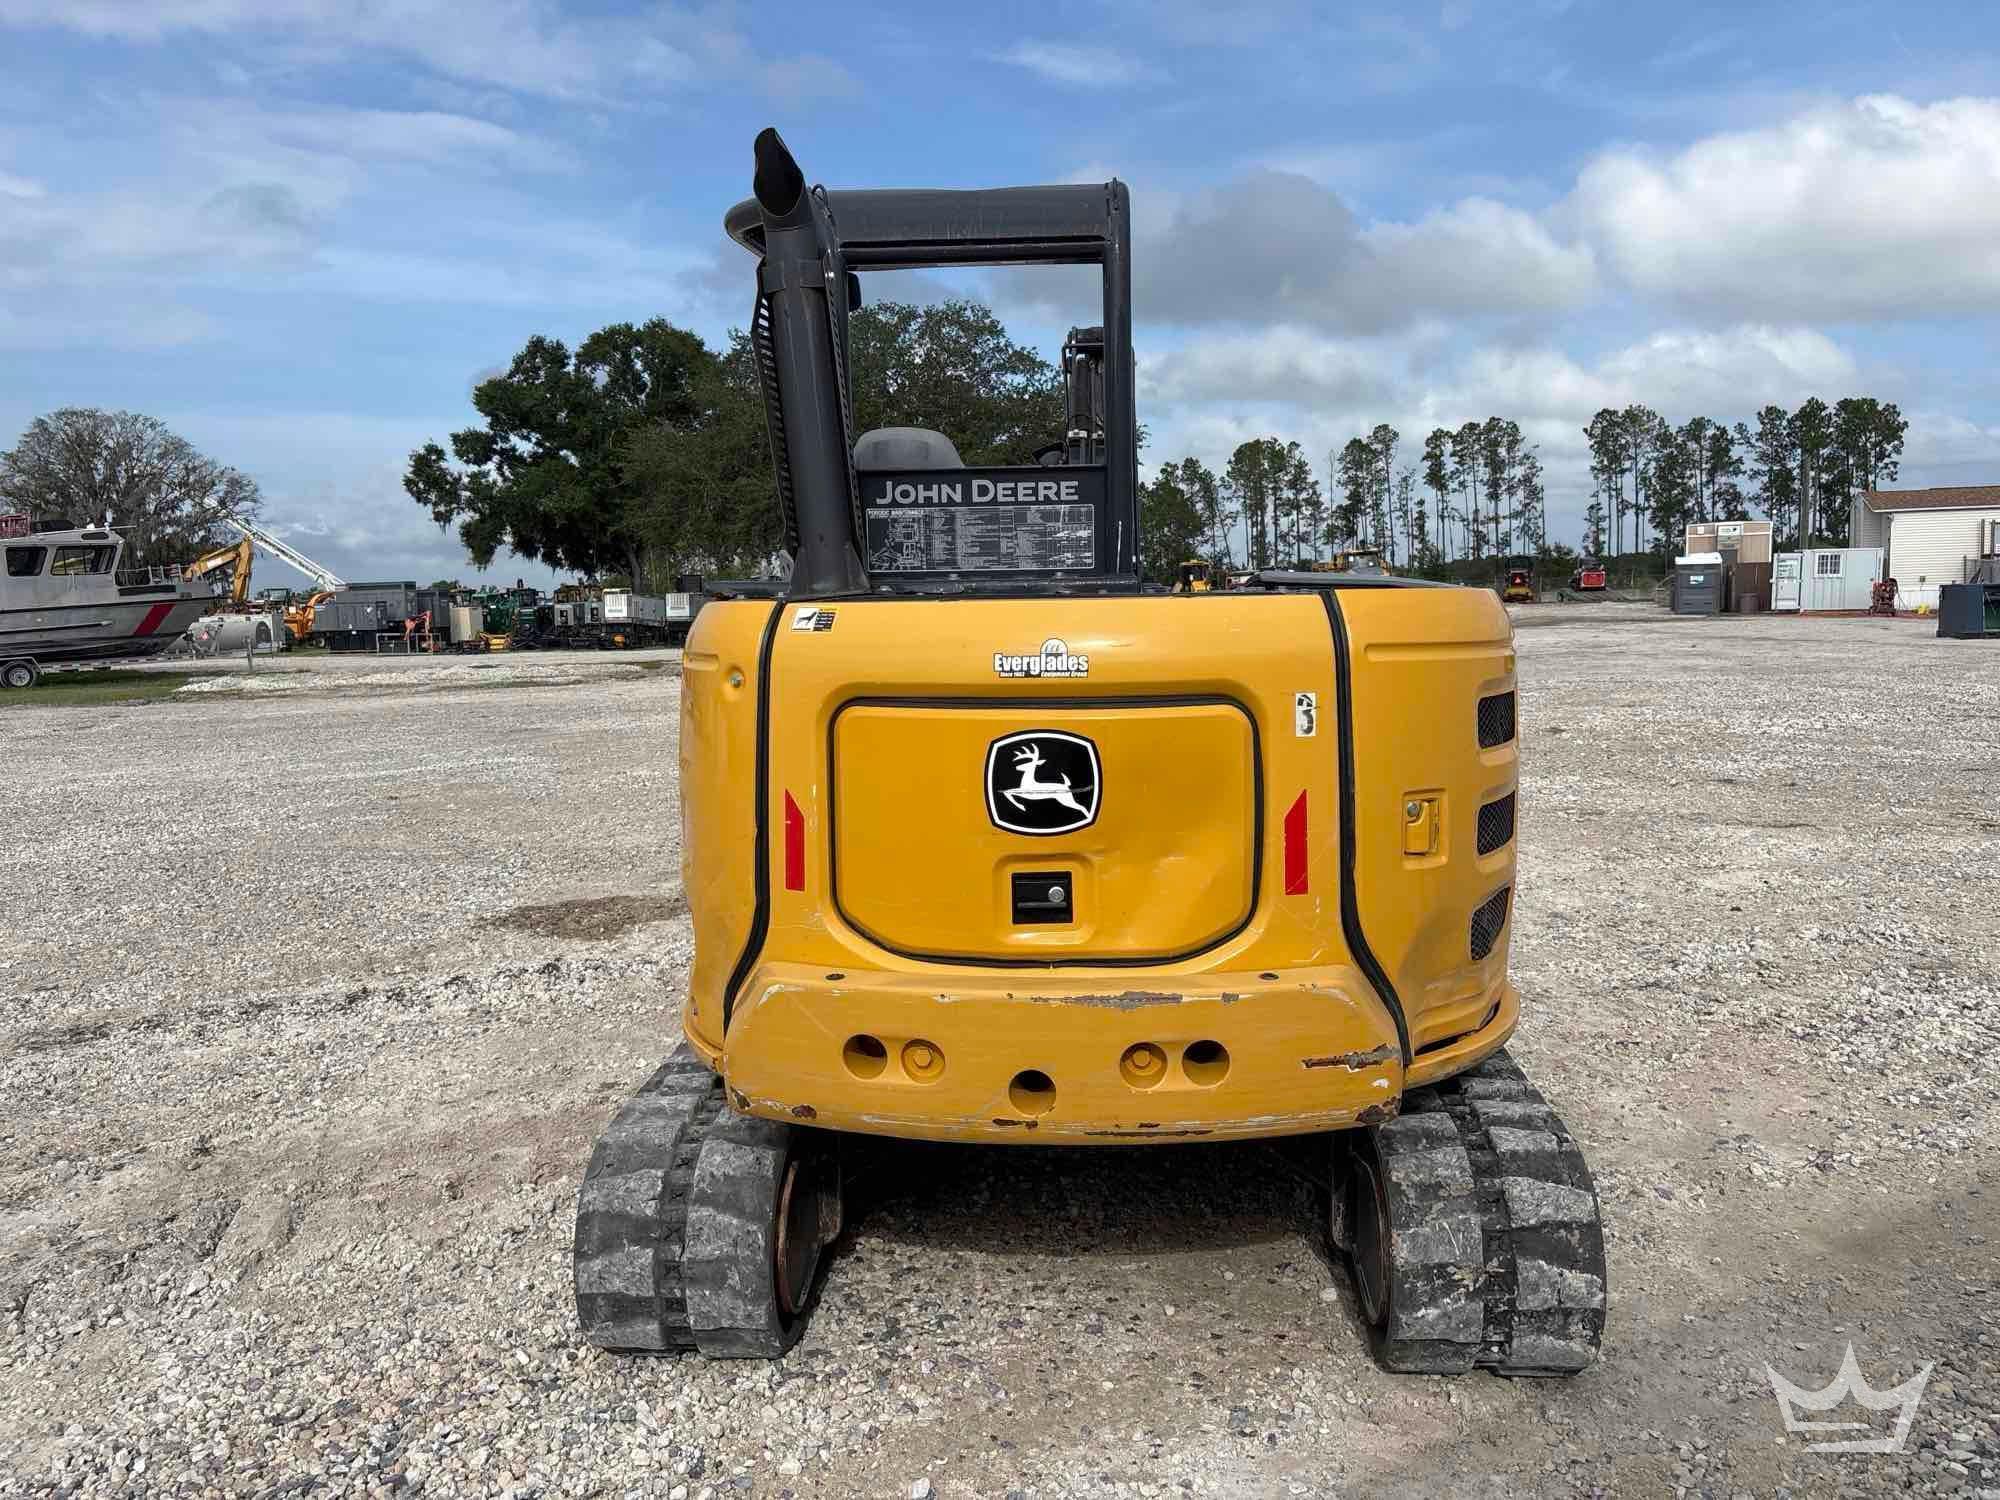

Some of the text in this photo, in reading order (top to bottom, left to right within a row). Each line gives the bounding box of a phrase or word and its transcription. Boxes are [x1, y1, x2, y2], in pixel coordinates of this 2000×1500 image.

[876, 480, 1080, 505] JOHN DEERE
[993, 653, 1089, 675] Everglades
